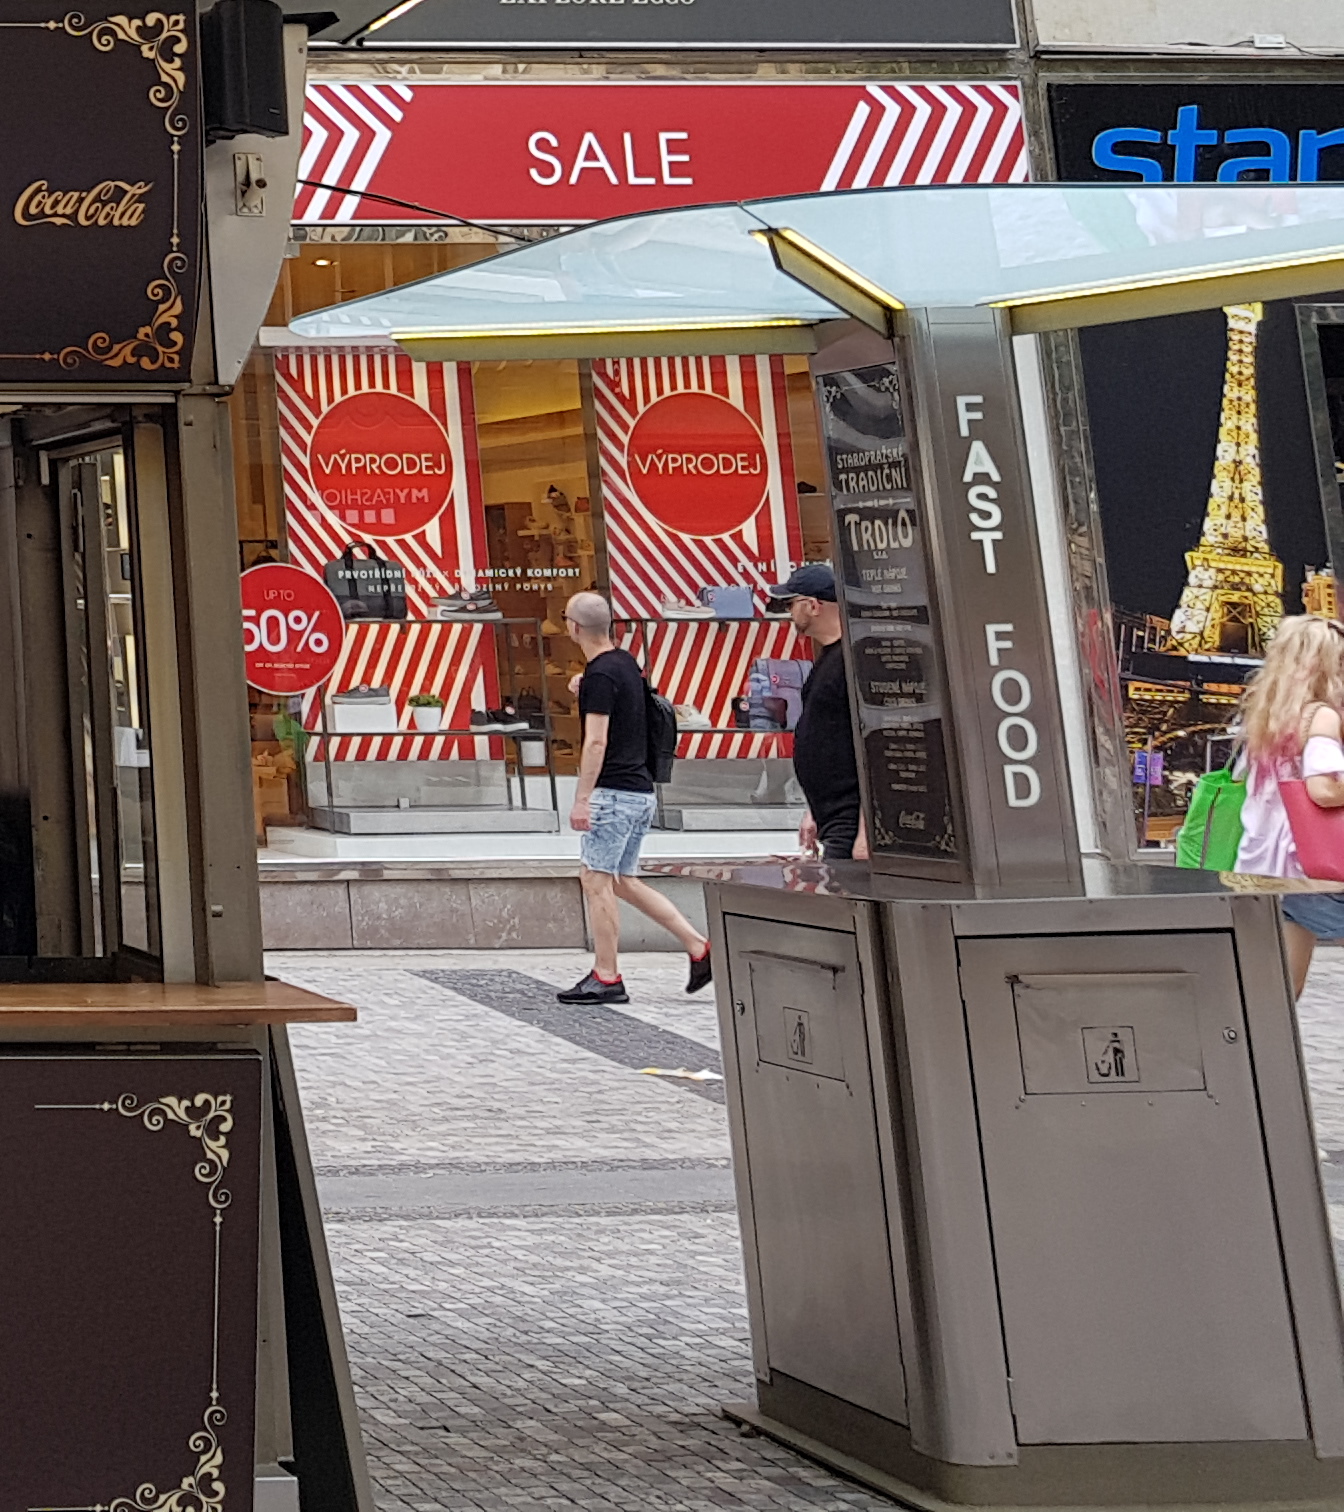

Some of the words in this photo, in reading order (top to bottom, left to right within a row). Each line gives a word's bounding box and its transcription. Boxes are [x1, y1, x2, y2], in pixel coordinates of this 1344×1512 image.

[527, 130, 694, 186] SALE
[316, 448, 447, 476] VÝPRODEJ
[634, 448, 762, 476] VÝPRODEJ
[836, 444, 904, 469] STAROPRAŽSKÉ
[838, 461, 909, 495] TRADIČNÍ
[955, 394, 1005, 575] FAST
[844, 508, 914, 552] TRDLO
[454, 567, 522, 578] DAMICKÝ
[527, 568, 580, 578] KOMFORT
[264, 589, 278, 601] UP
[279, 589, 295, 601] TO
[242, 608, 330, 655] 50%
[984, 623, 1042, 810] FOOD
